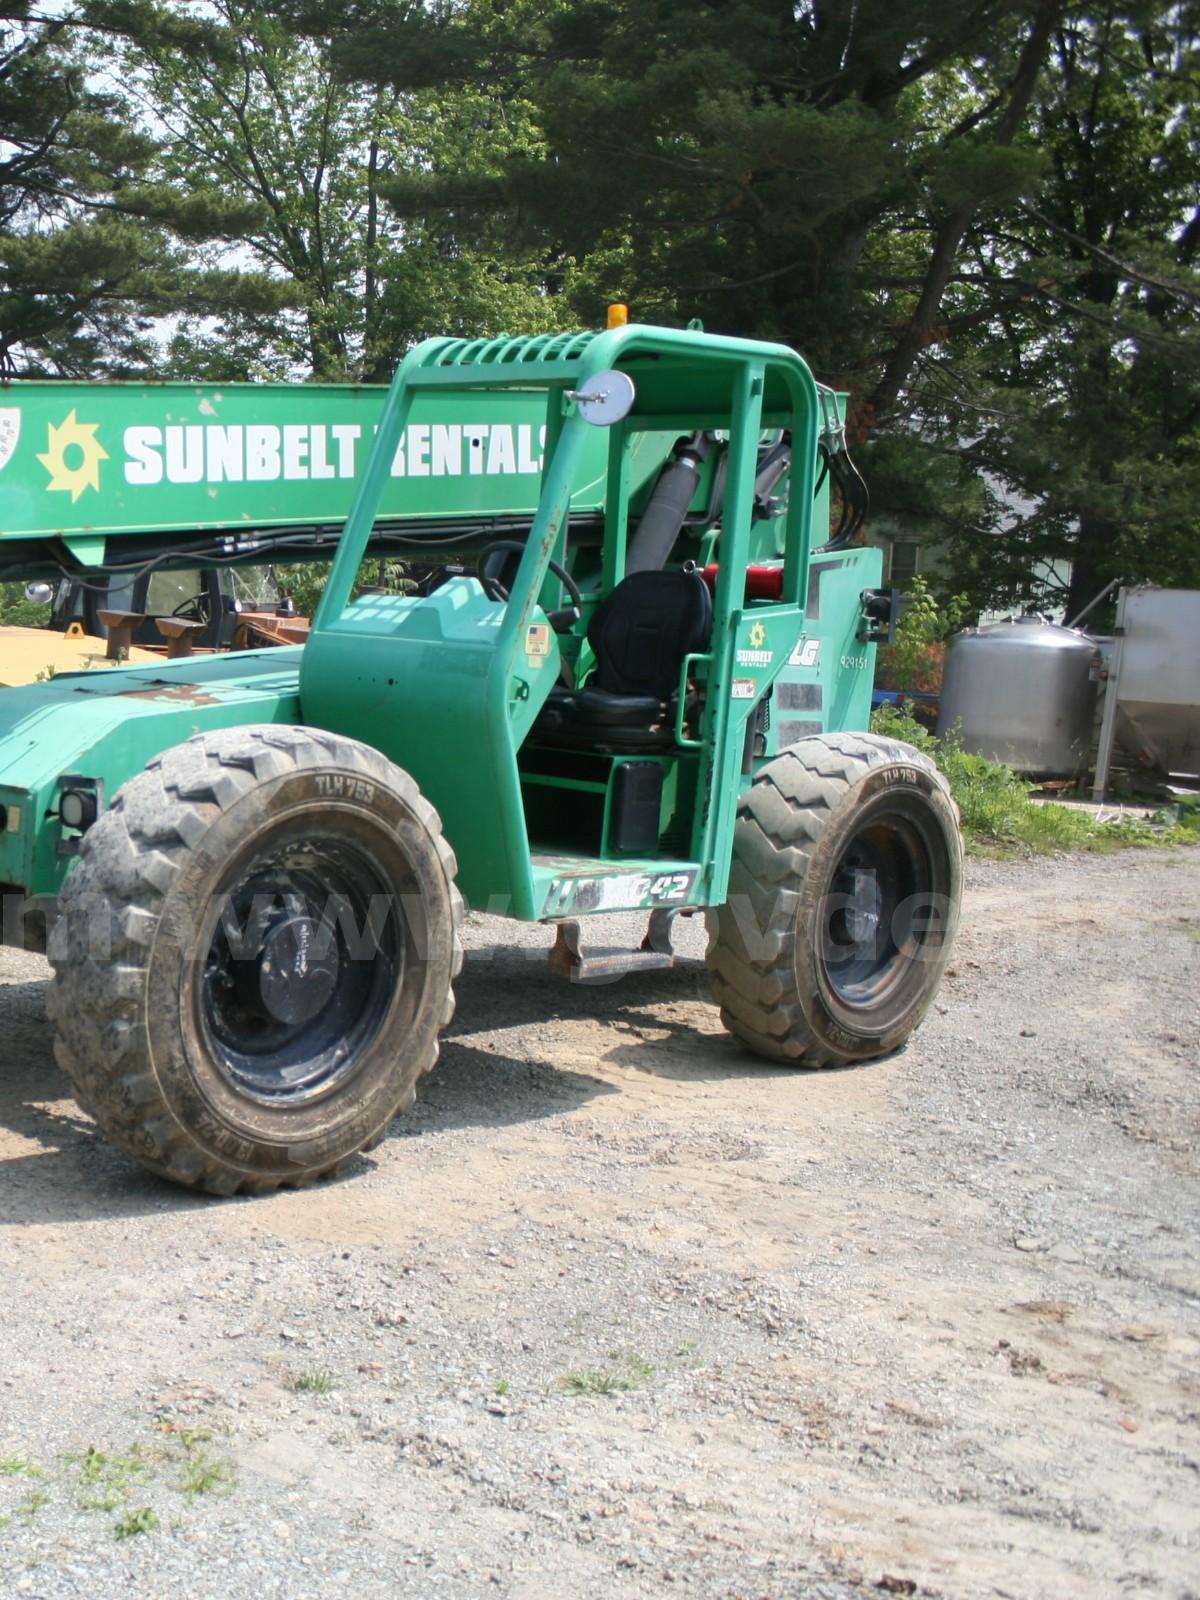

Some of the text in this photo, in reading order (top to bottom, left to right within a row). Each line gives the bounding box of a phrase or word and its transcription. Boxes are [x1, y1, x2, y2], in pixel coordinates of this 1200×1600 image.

[123, 424, 547, 484] SUNBELT ENTAL
[736, 649, 774, 663] SUNBELT
[881, 768, 917, 785] TLH 753
[314, 775, 375, 804] TLH 753
